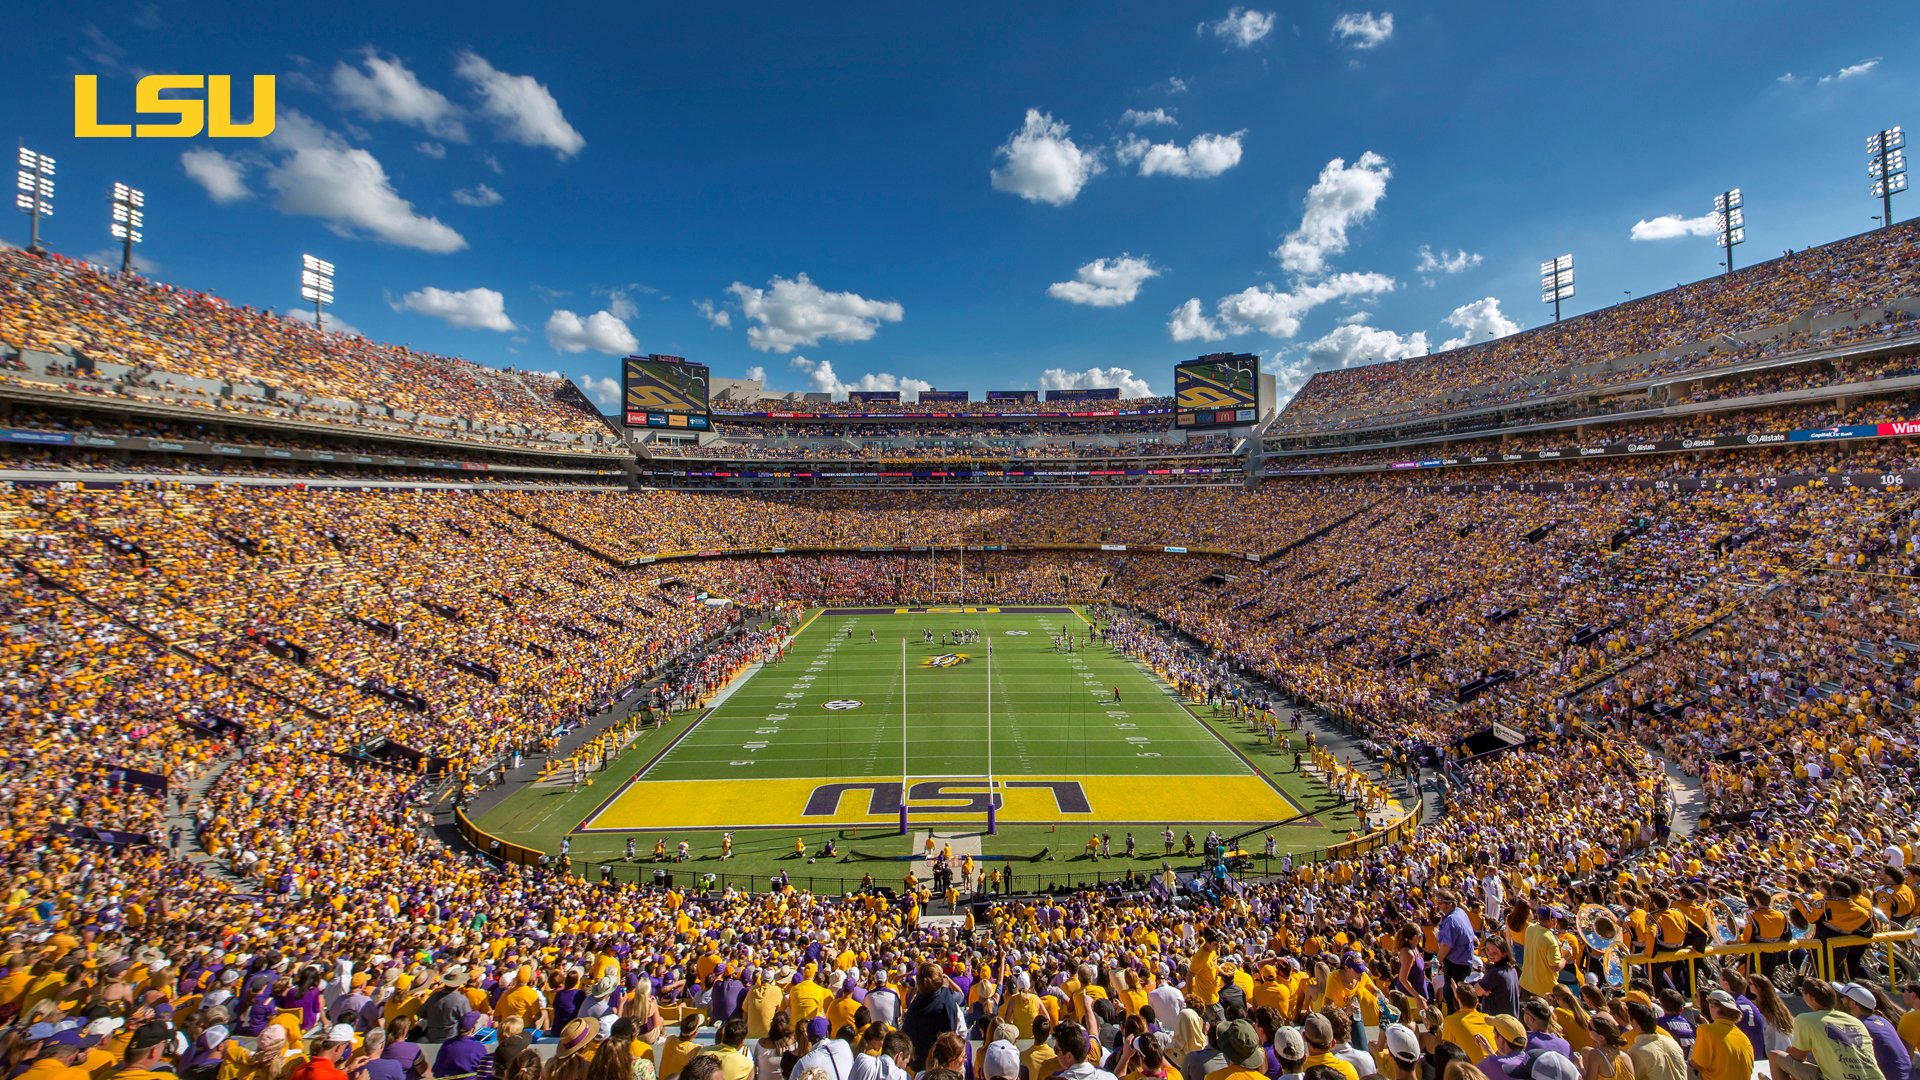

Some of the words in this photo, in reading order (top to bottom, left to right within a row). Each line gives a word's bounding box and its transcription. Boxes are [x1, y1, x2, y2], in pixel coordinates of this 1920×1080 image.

[1759, 434, 1785, 442] Allstate
[1693, 439, 1715, 447] Allstate
[1881, 474, 1903, 485] 106
[1655, 481, 1669, 489] 104
[801, 780, 1093, 816] LSU
[1740, 1004, 1755, 1027] 7
